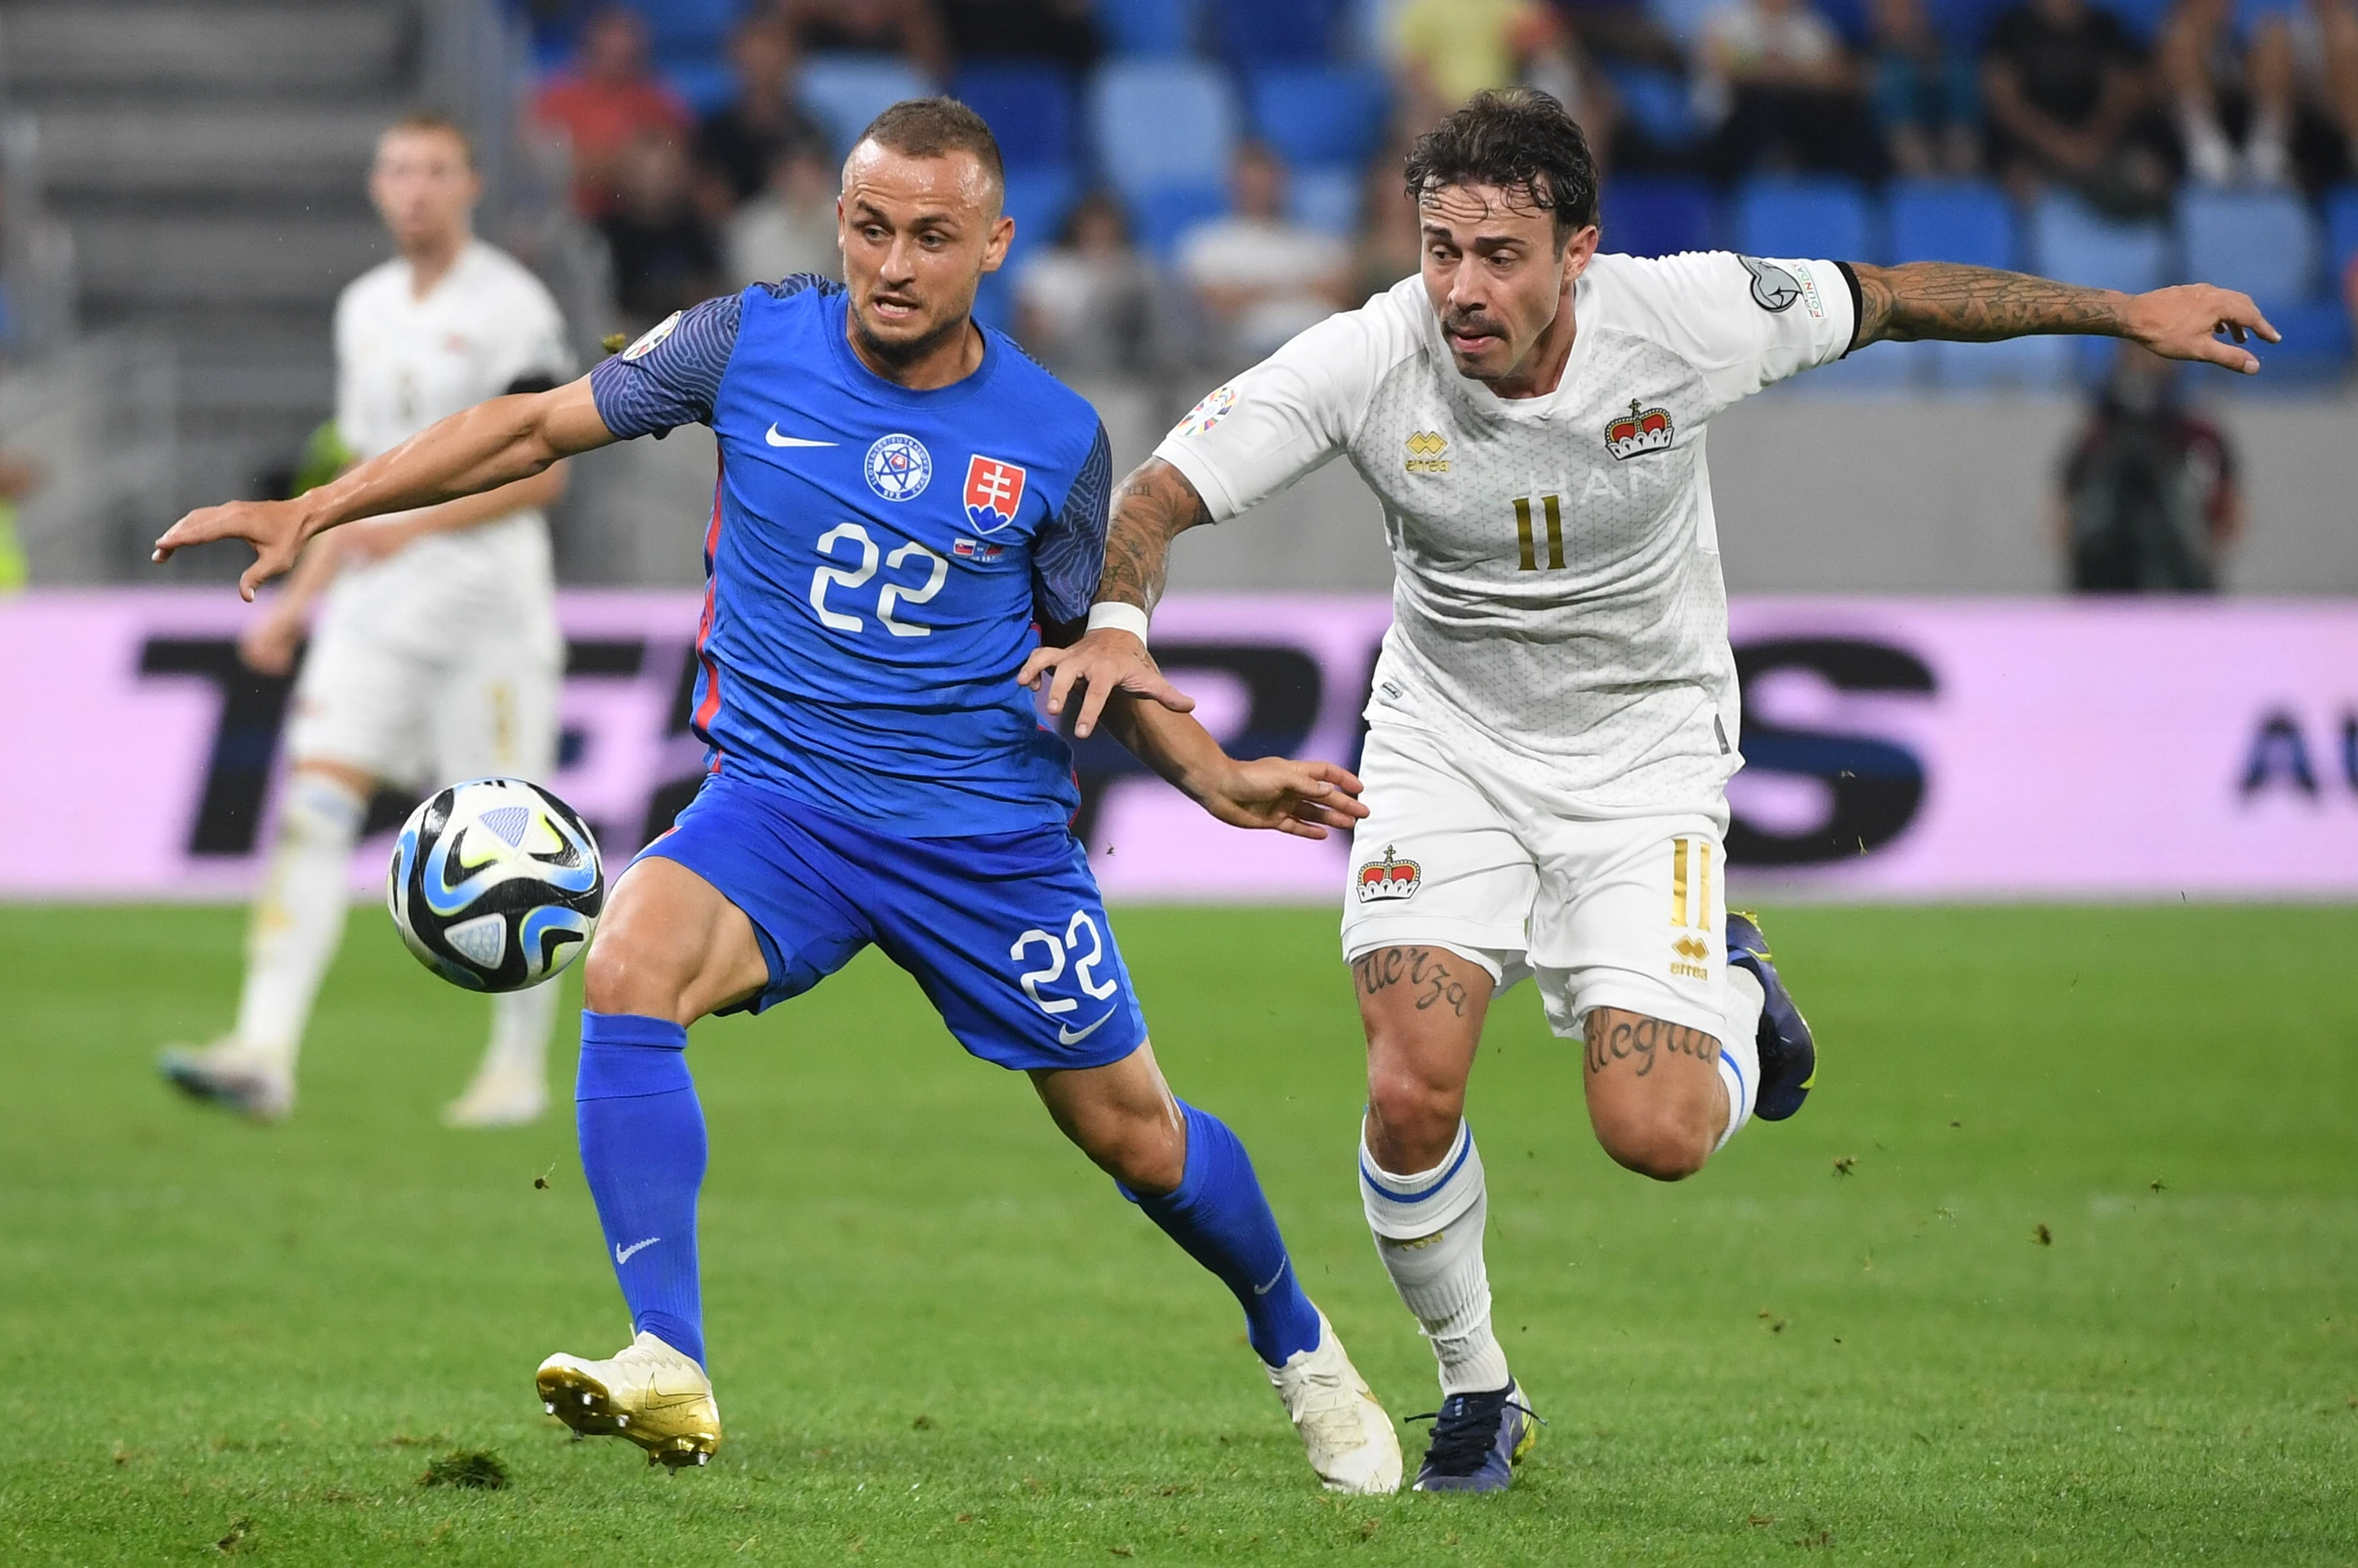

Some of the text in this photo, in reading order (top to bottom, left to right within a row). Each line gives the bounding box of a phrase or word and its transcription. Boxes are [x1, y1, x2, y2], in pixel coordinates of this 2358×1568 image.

[809, 523, 948, 637] 22
[1512, 495, 1567, 571] 11
[1670, 838, 1711, 933] 11
[1010, 910, 1117, 1013] 22
